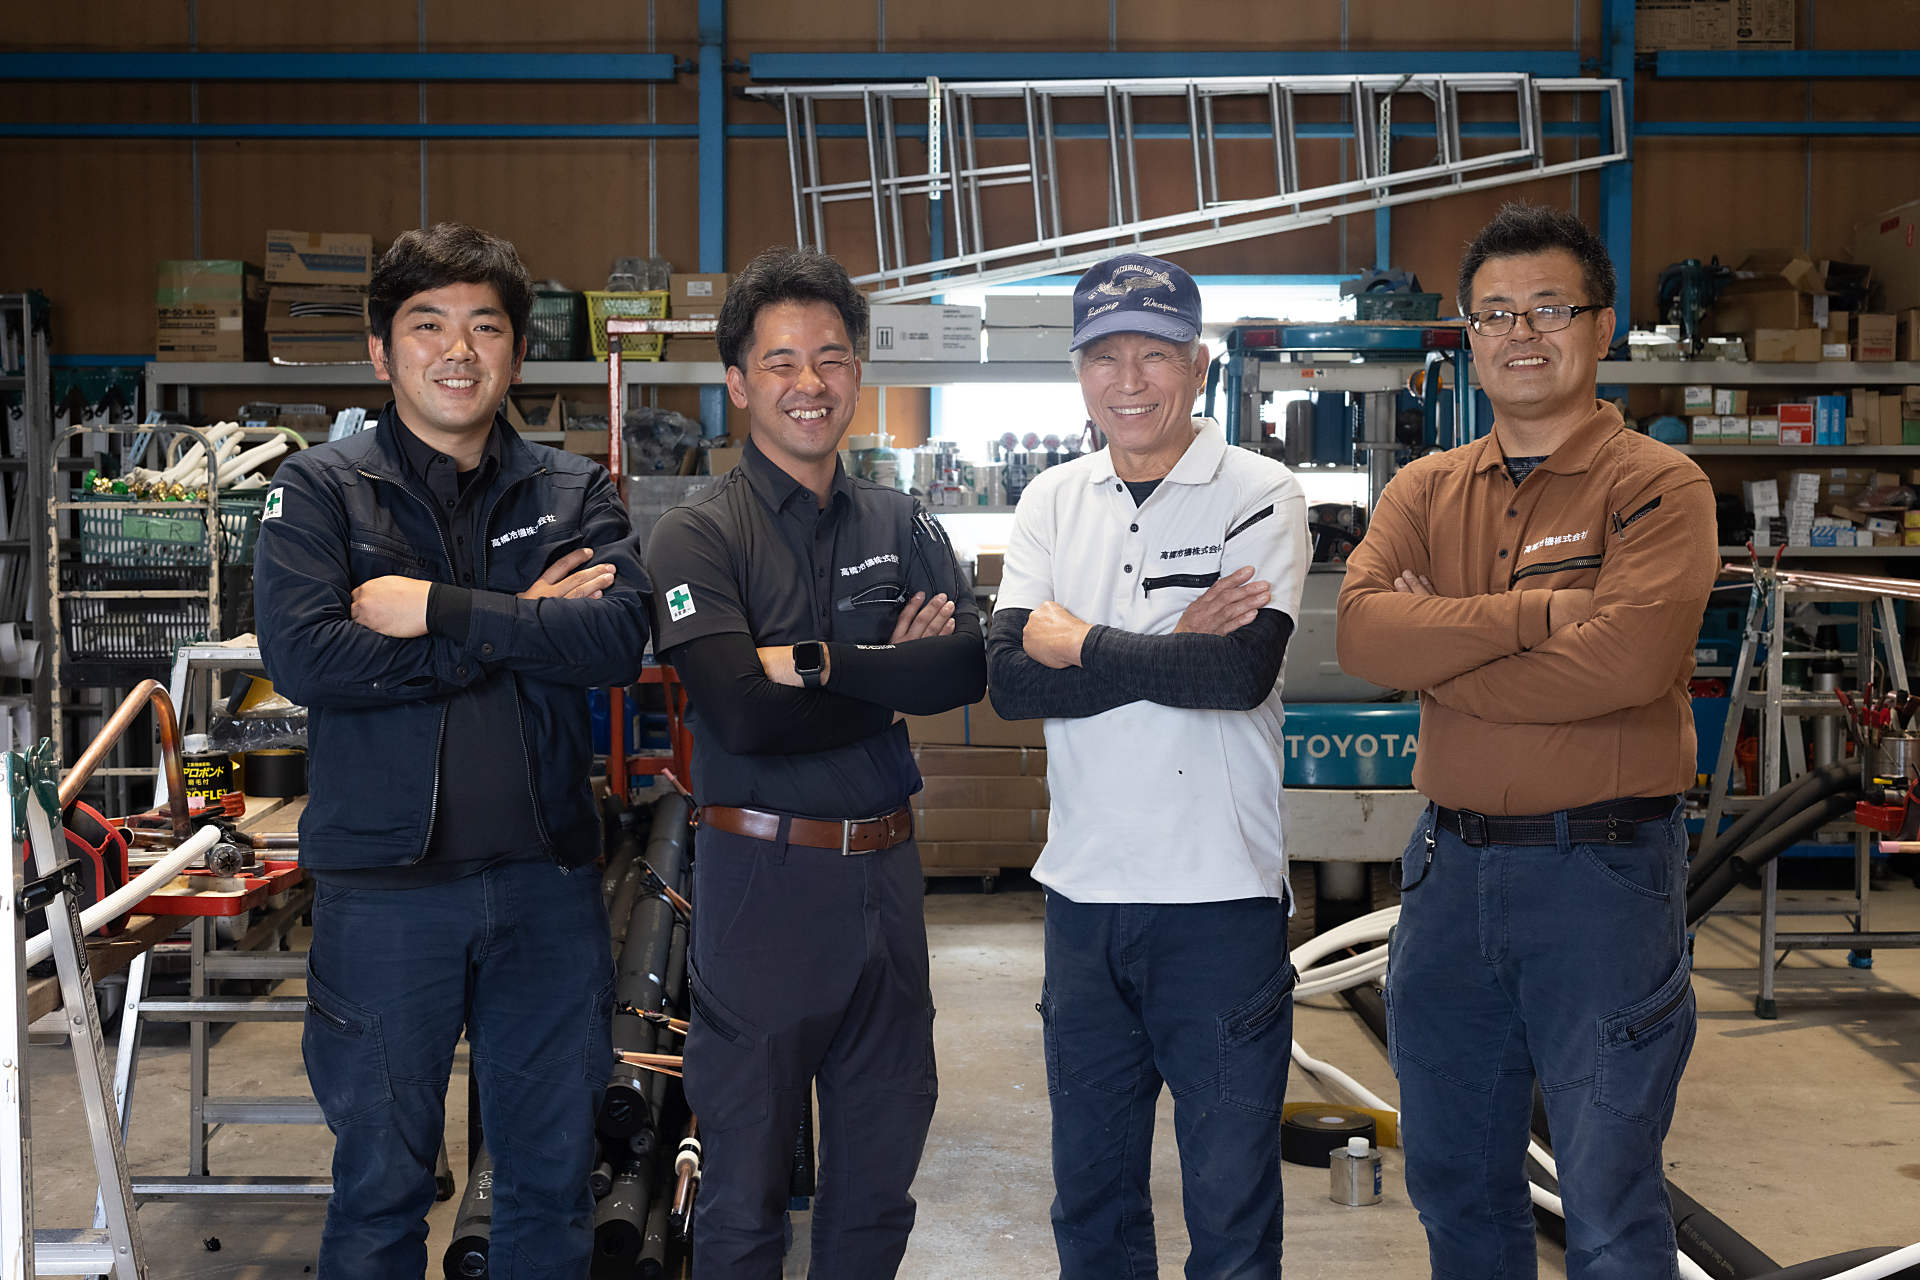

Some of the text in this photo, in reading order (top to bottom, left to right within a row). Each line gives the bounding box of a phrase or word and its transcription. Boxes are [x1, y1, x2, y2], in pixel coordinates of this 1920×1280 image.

[491, 513, 556, 548] 高橋冷機株会社
[1284, 733, 1418, 759] TOYOTA
